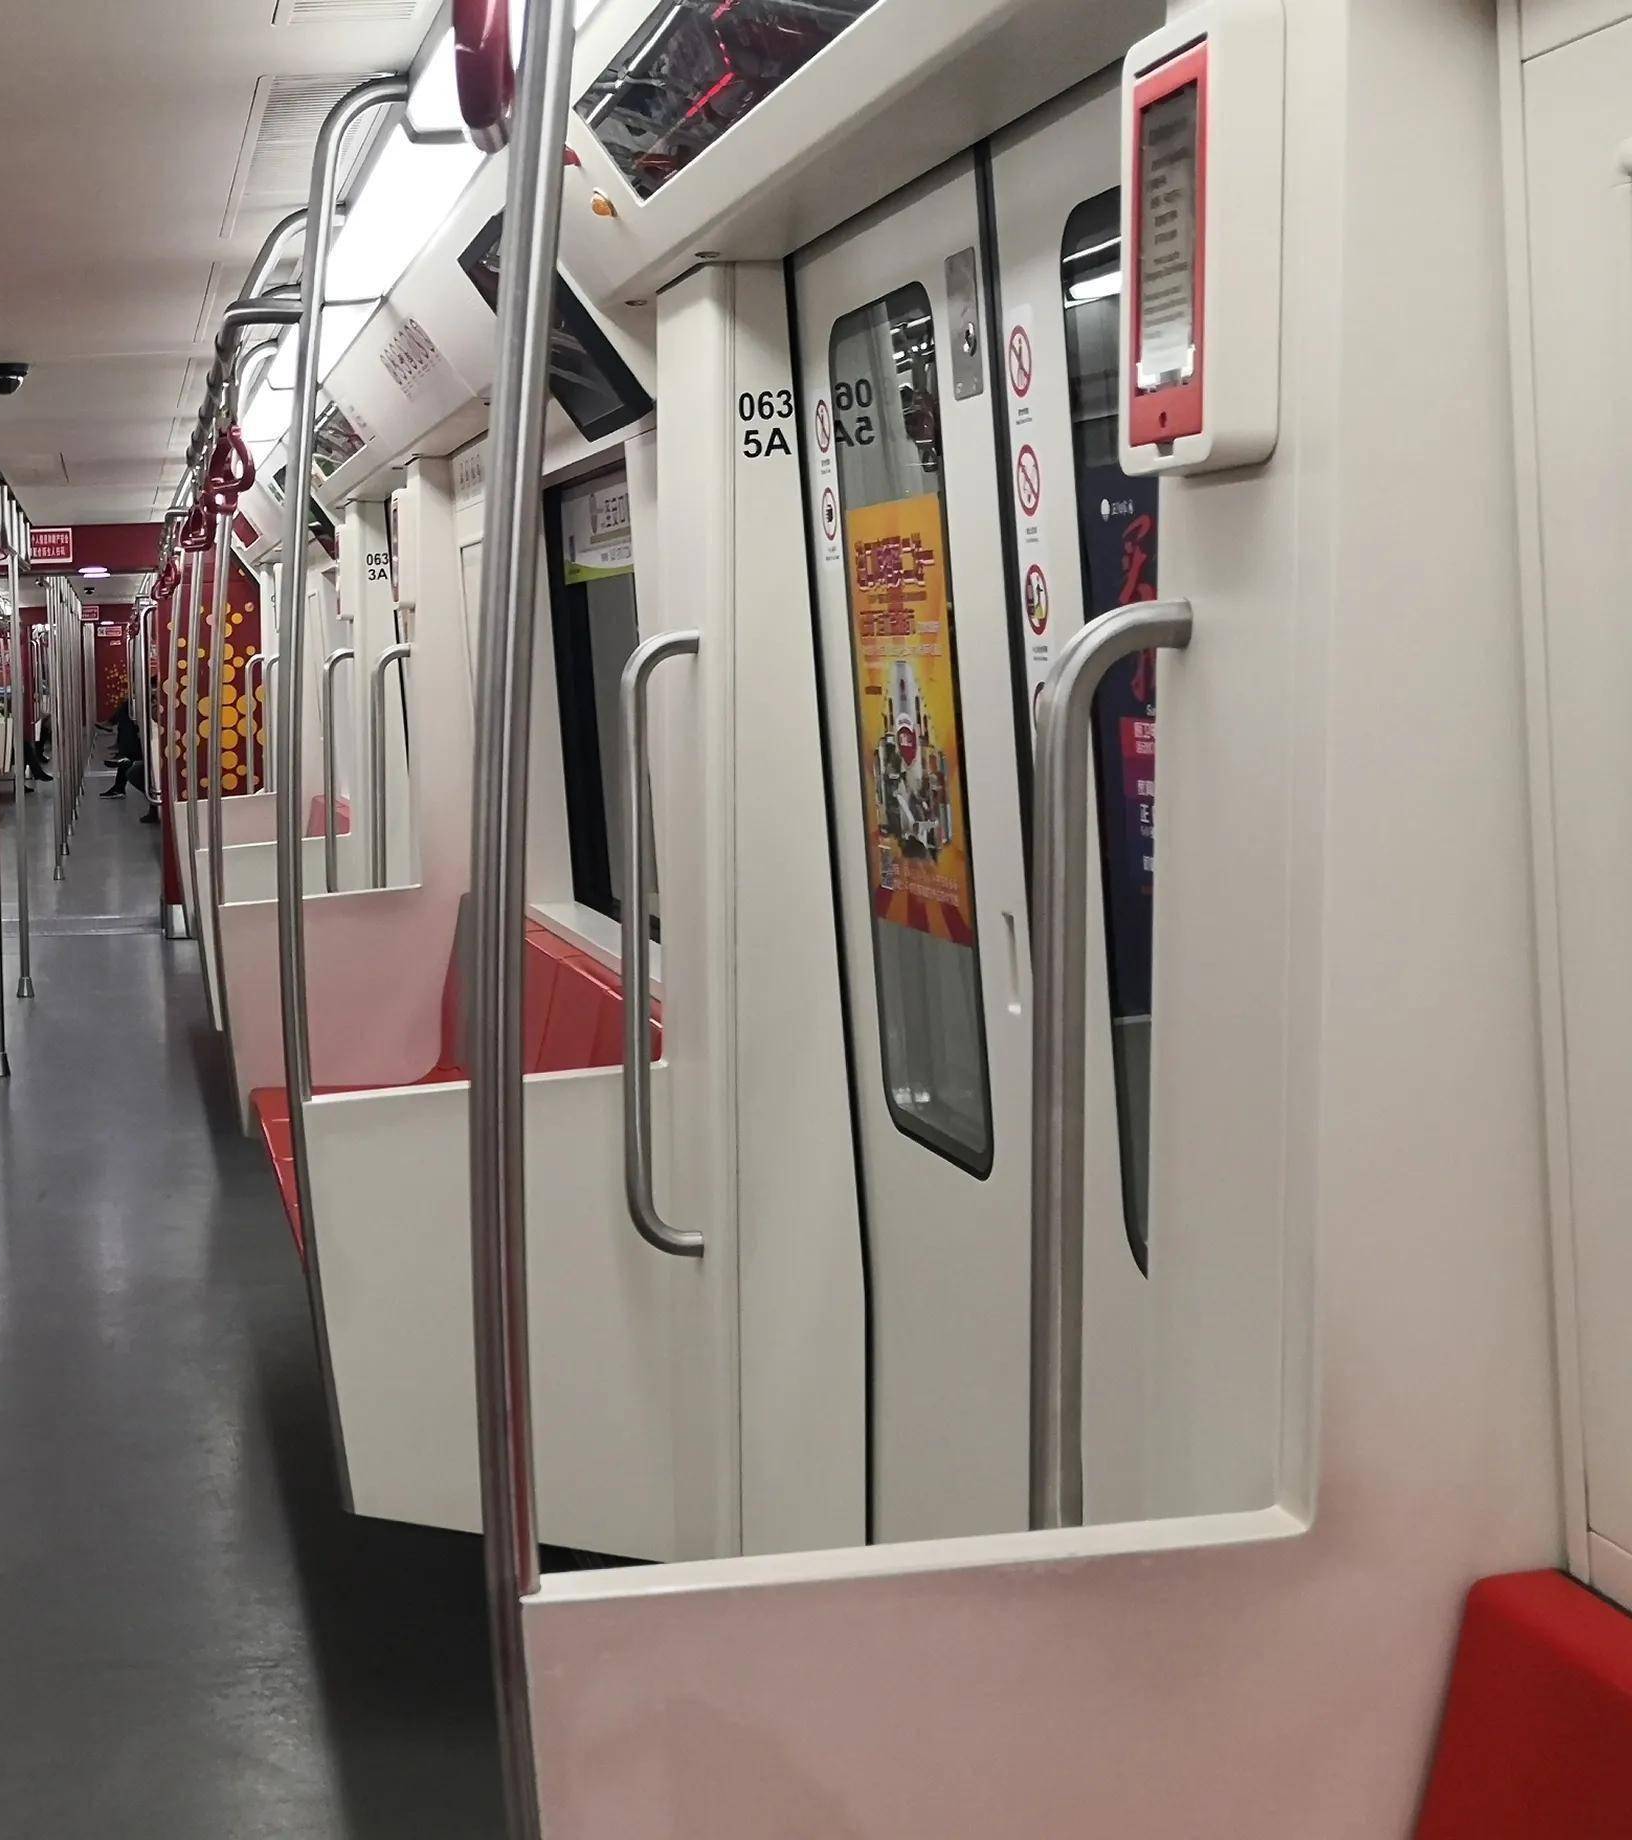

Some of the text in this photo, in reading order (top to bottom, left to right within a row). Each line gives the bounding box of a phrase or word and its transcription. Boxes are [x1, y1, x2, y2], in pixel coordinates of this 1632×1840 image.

[739, 389, 794, 421] 063
[743, 427, 792, 458] 5A
[366, 552, 389, 566] 063
[368, 567, 388, 581] 3A
